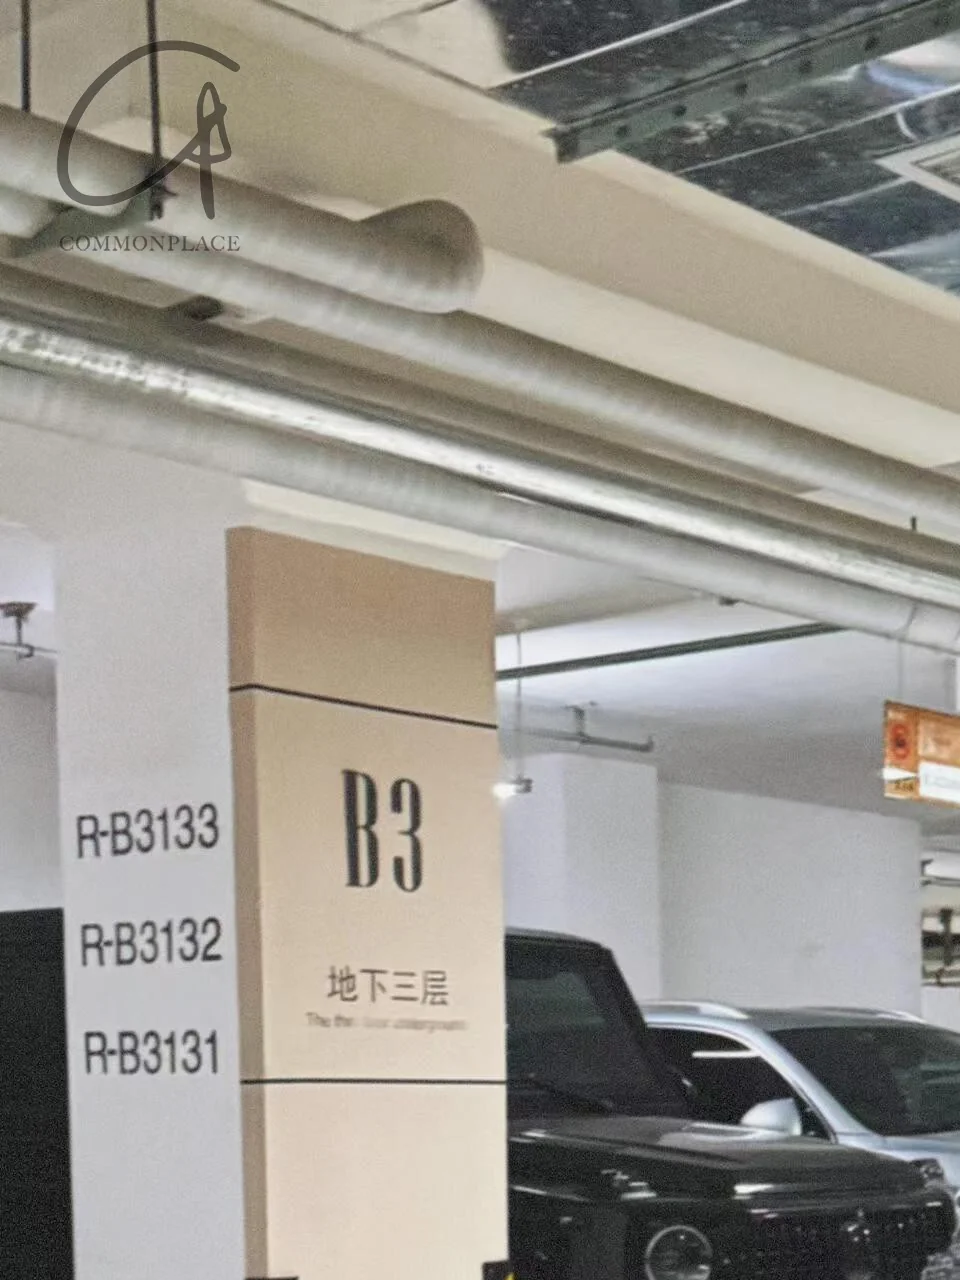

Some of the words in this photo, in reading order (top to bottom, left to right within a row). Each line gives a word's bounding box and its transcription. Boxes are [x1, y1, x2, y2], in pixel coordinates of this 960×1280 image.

[76, 804, 219, 858] R-B3133
[342, 769, 423, 892] B3
[81, 917, 222, 966] R-B3132
[327, 965, 448, 1006] 地下三层
[84, 1030, 218, 1074] R-B3131
